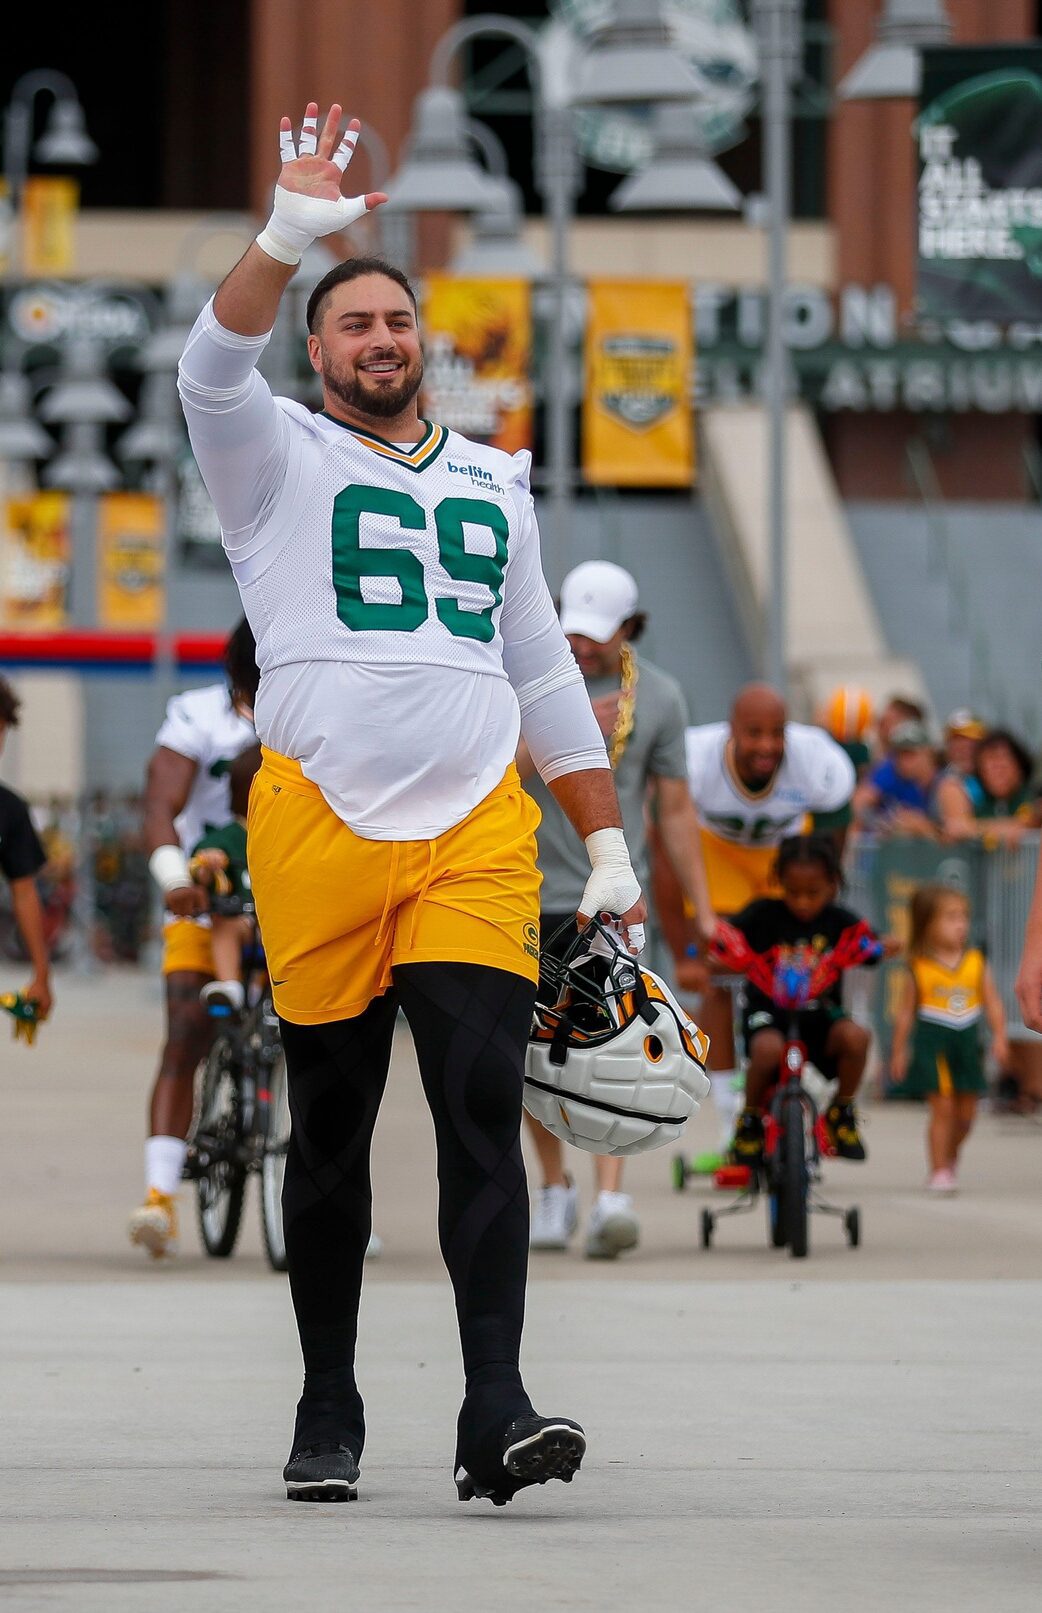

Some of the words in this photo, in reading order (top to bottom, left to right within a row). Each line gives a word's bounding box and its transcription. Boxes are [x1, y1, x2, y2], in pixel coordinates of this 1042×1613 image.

[447, 461, 493, 482] bellin
[471, 476, 505, 496] health
[331, 483, 510, 643] 69
